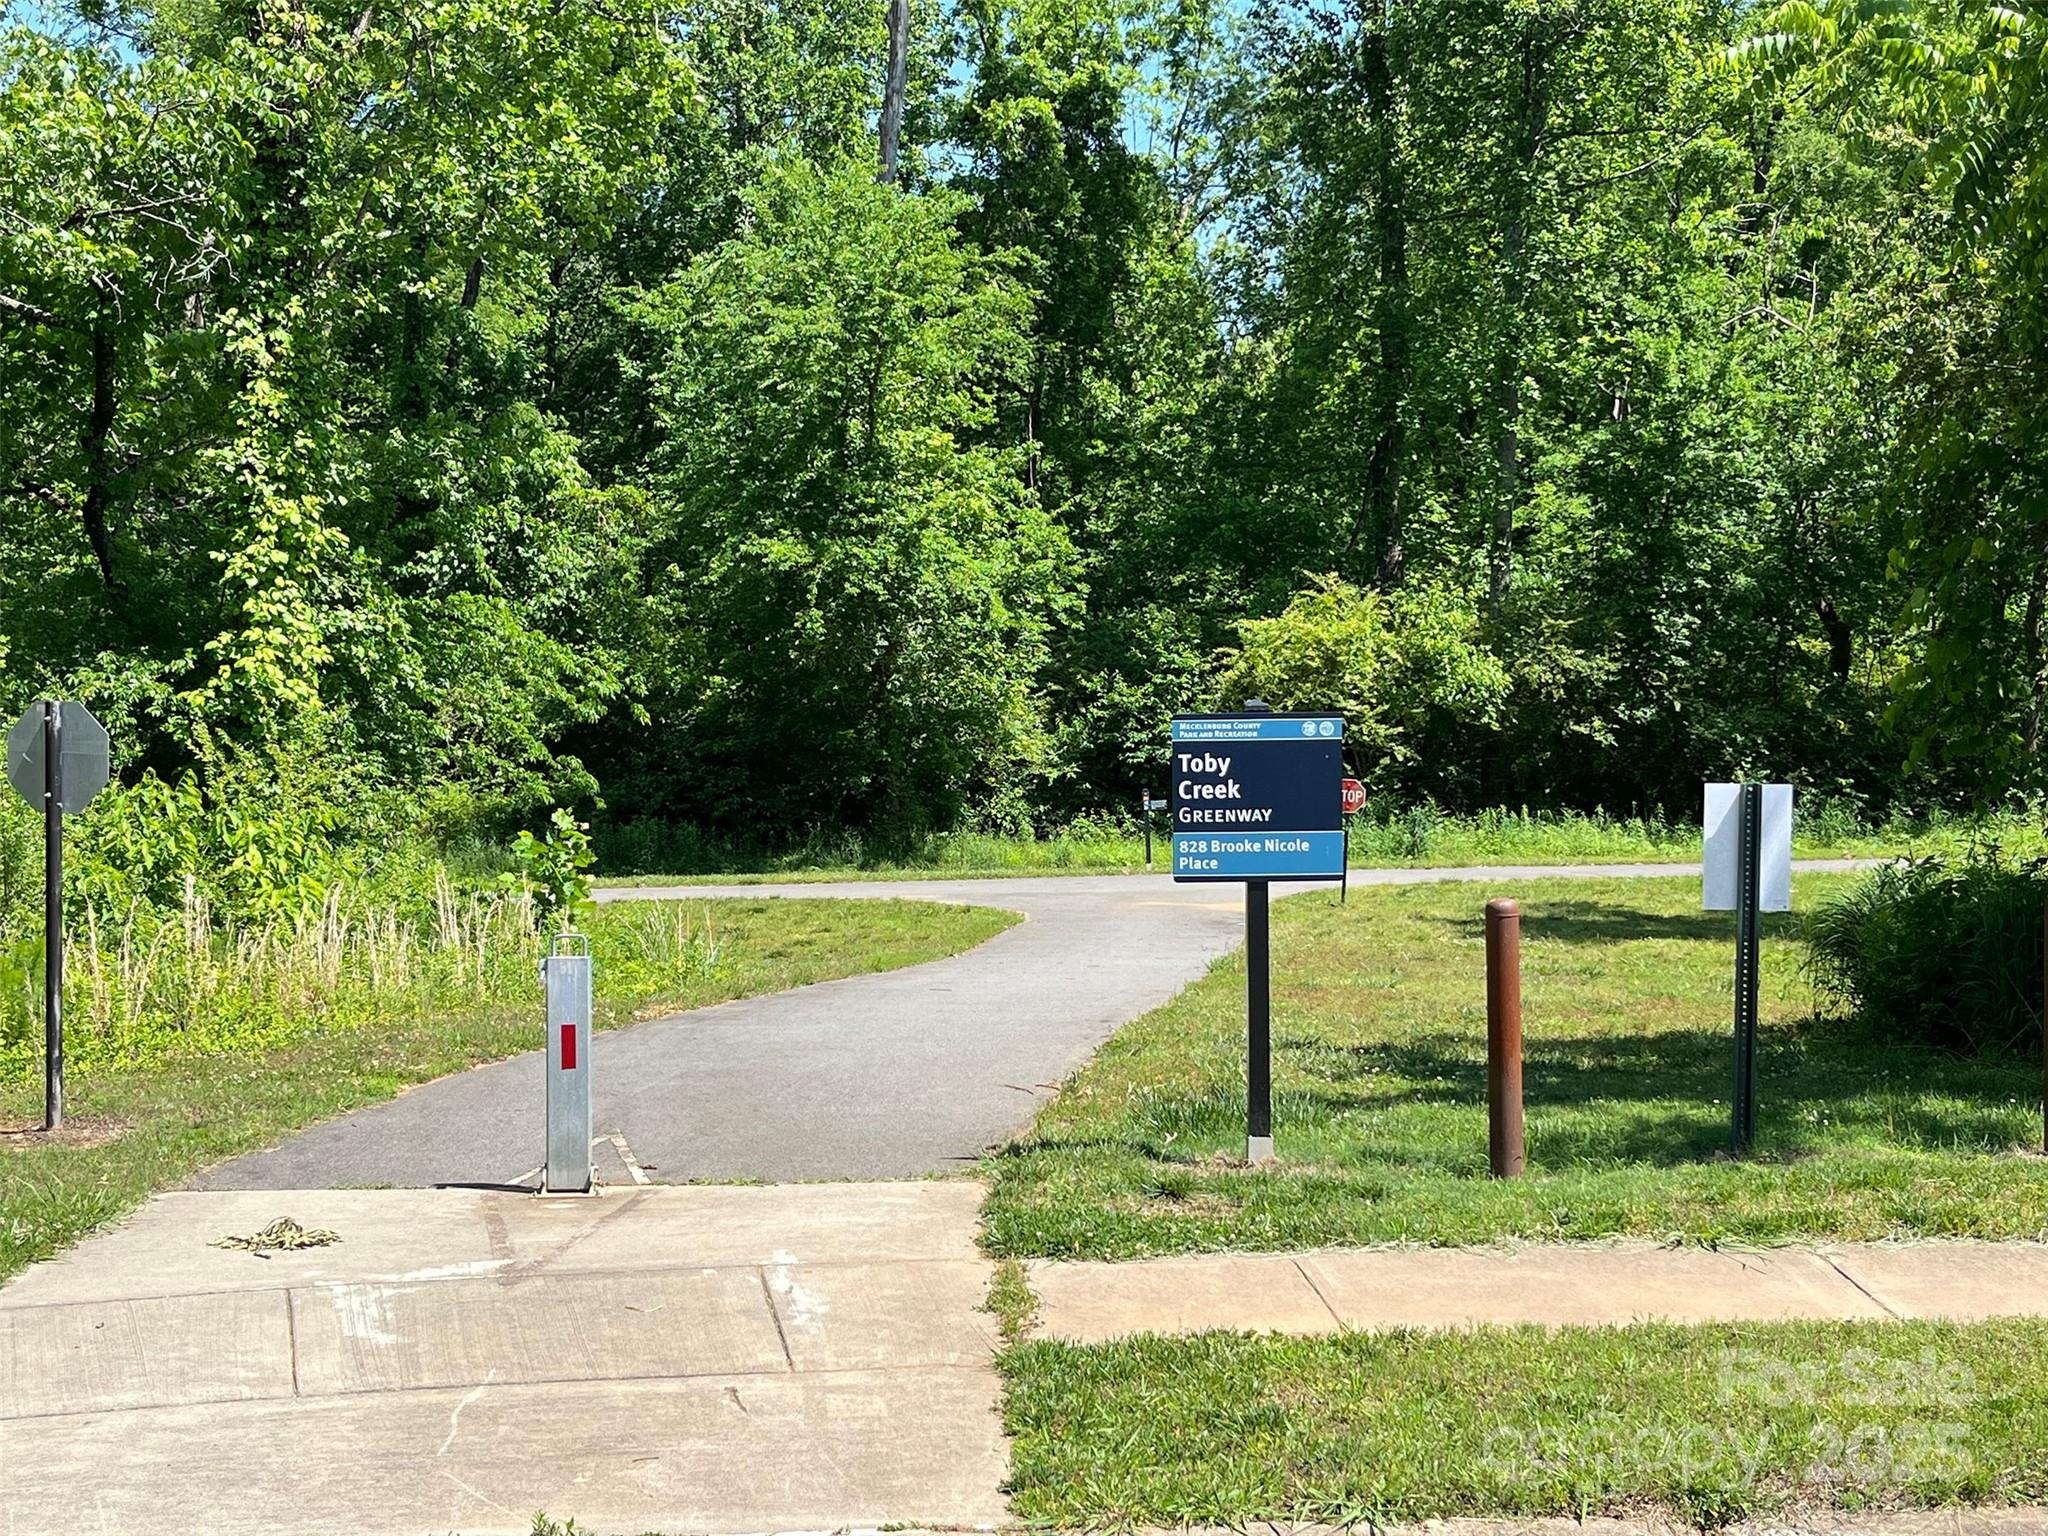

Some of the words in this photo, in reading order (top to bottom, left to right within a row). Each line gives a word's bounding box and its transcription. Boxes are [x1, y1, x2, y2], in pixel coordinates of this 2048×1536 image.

[1178, 752, 1231, 777] Toby
[1178, 779, 1241, 800] Creek
[1341, 790, 1363, 803] TOP
[1178, 807, 1272, 823] GREENWAY
[1179, 840, 1208, 853] 828
[1211, 839, 1262, 853] Brooke
[1264, 838, 1310, 852] Nicole
[1179, 857, 1219, 870] Place
